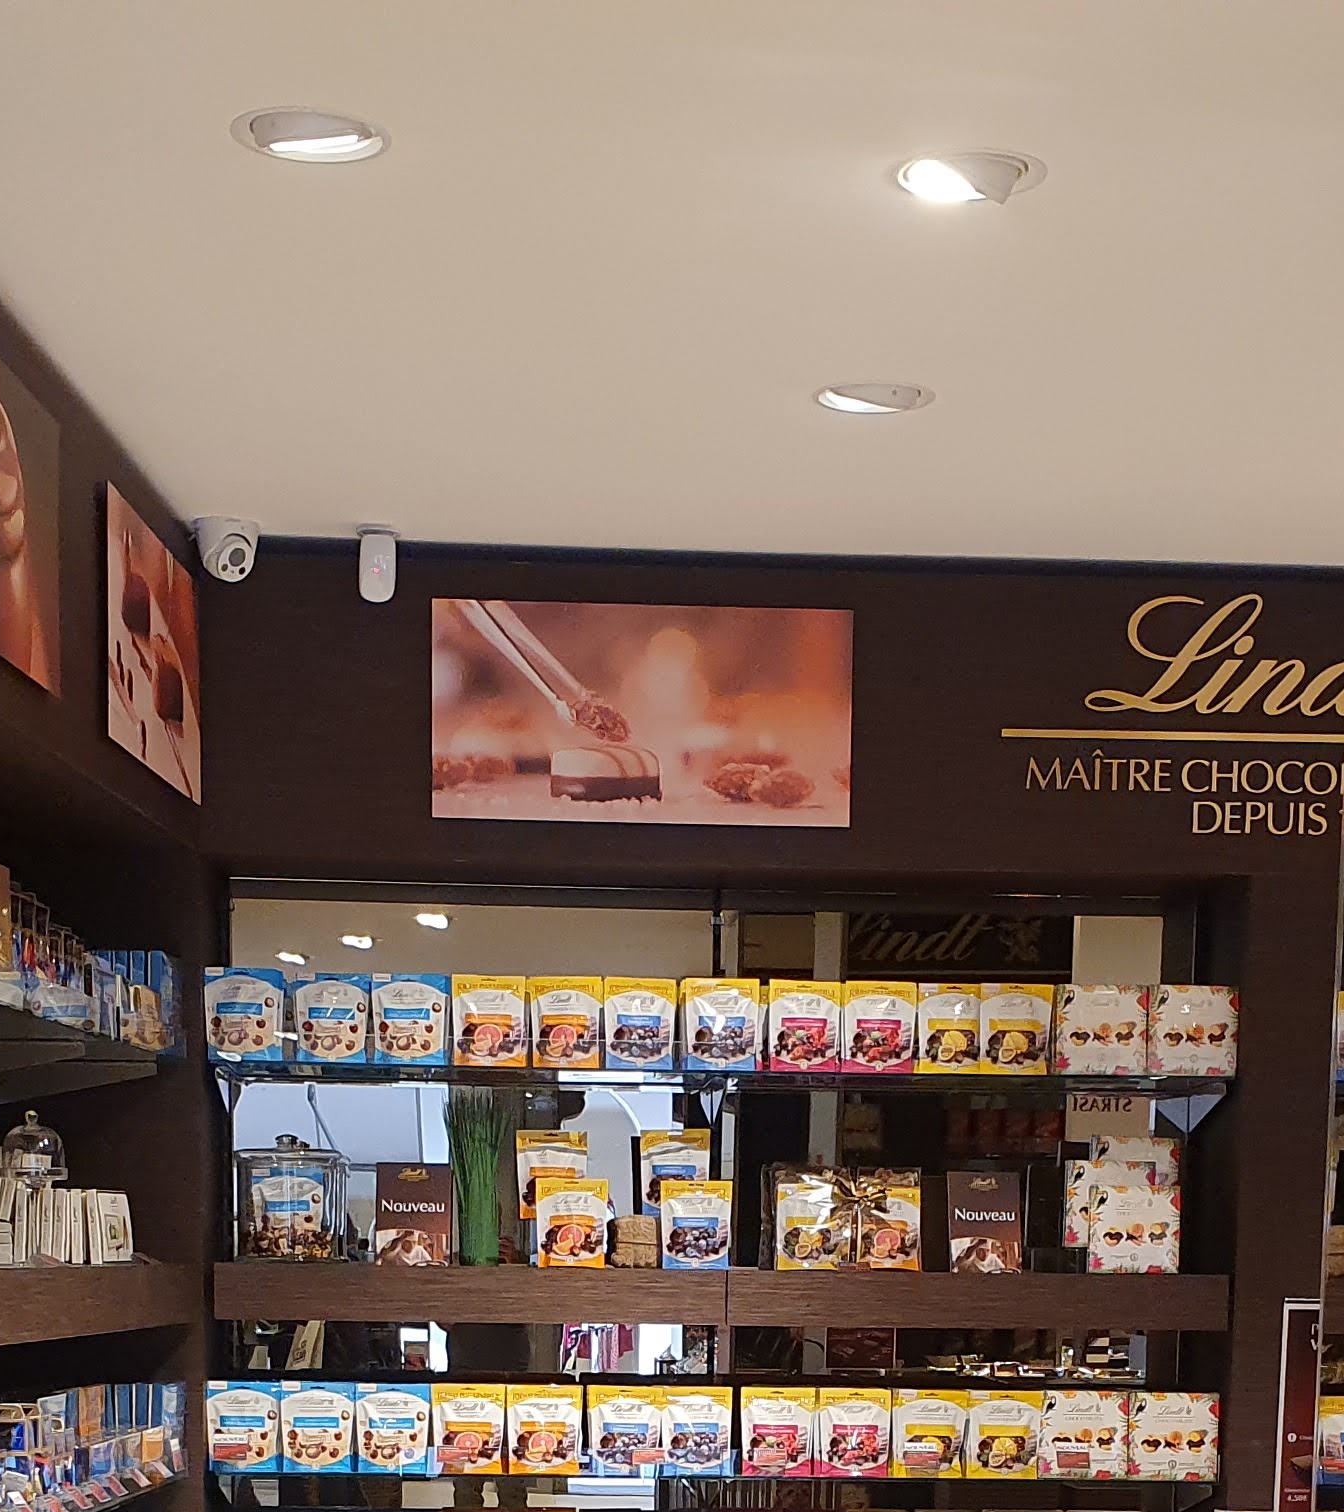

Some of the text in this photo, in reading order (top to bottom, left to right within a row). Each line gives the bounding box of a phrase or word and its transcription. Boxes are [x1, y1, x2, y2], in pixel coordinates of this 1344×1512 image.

[1025, 748, 1344, 795] MAÎTRE CHOCO
[1192, 800, 1328, 836] DEPUIS
[381, 1199, 446, 1213] Nouveau
[954, 1207, 1015, 1221] Nouveau
